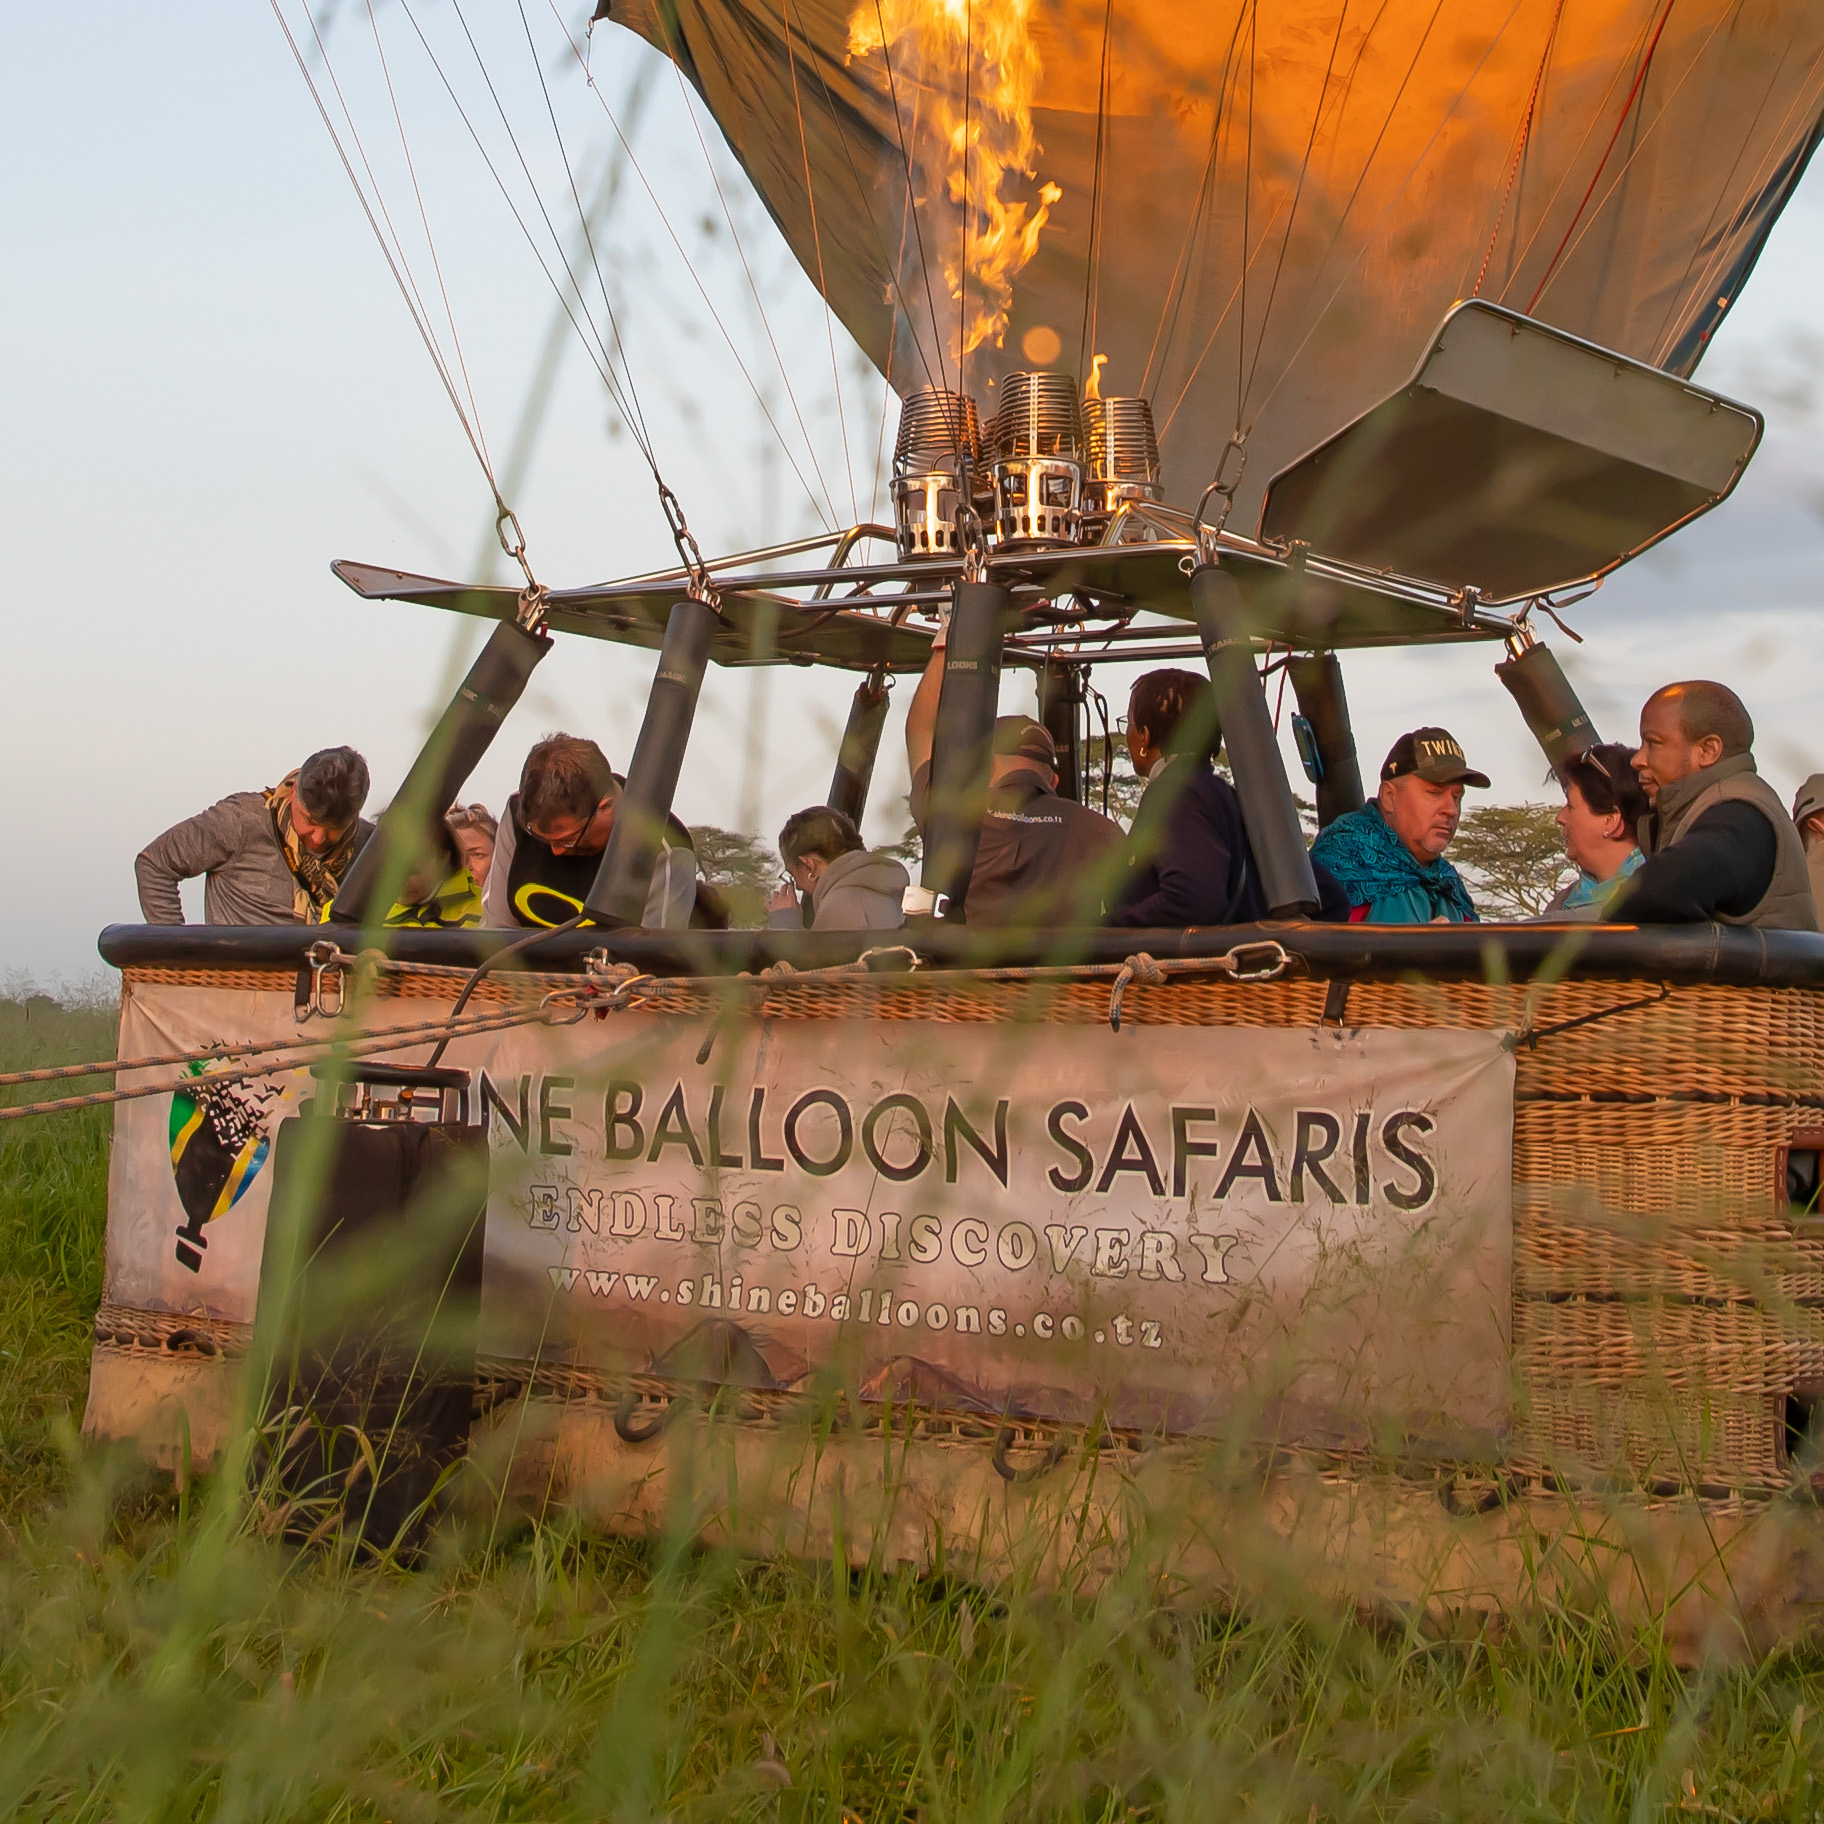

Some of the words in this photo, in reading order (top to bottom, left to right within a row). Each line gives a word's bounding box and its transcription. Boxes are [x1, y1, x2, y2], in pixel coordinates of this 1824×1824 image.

[604, 1079, 1010, 1189] BALLOON
[1046, 1099, 1439, 1213] SAFARIS
[528, 1184, 804, 1251] ENDLESS
[830, 1207, 1239, 1284] DISCOVERY
[547, 1266, 1163, 1350] www.shineballoons.co.tz
